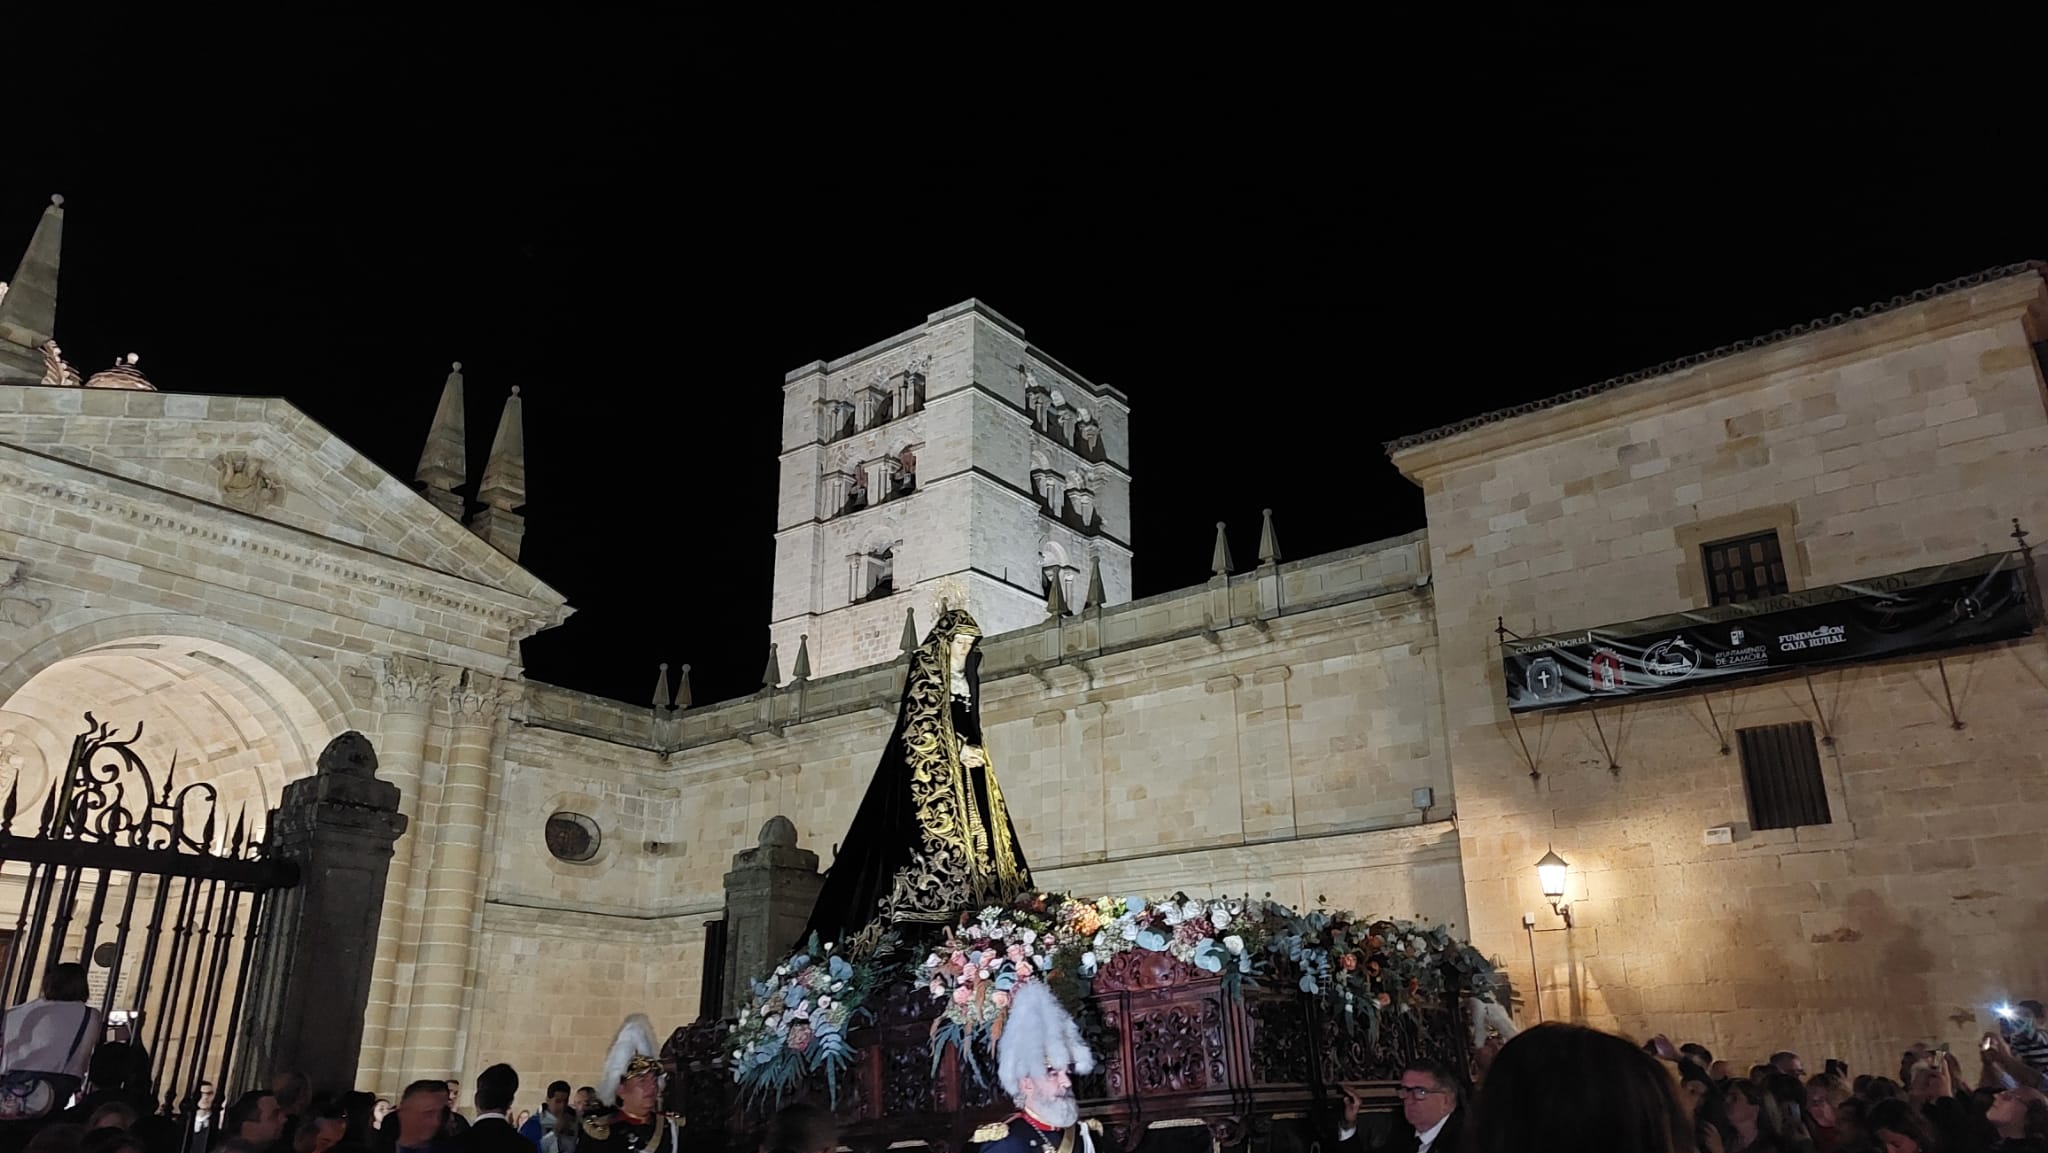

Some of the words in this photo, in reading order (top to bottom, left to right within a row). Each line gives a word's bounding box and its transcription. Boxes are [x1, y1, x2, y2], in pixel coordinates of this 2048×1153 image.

[1780, 641, 1806, 652] CAJA
[1809, 634, 1847, 647] RURAL
[1715, 645, 1767, 659] AYUNTAMIENTO
[1715, 658, 1727, 666] DE
[1728, 652, 1768, 665] ZAMORA
